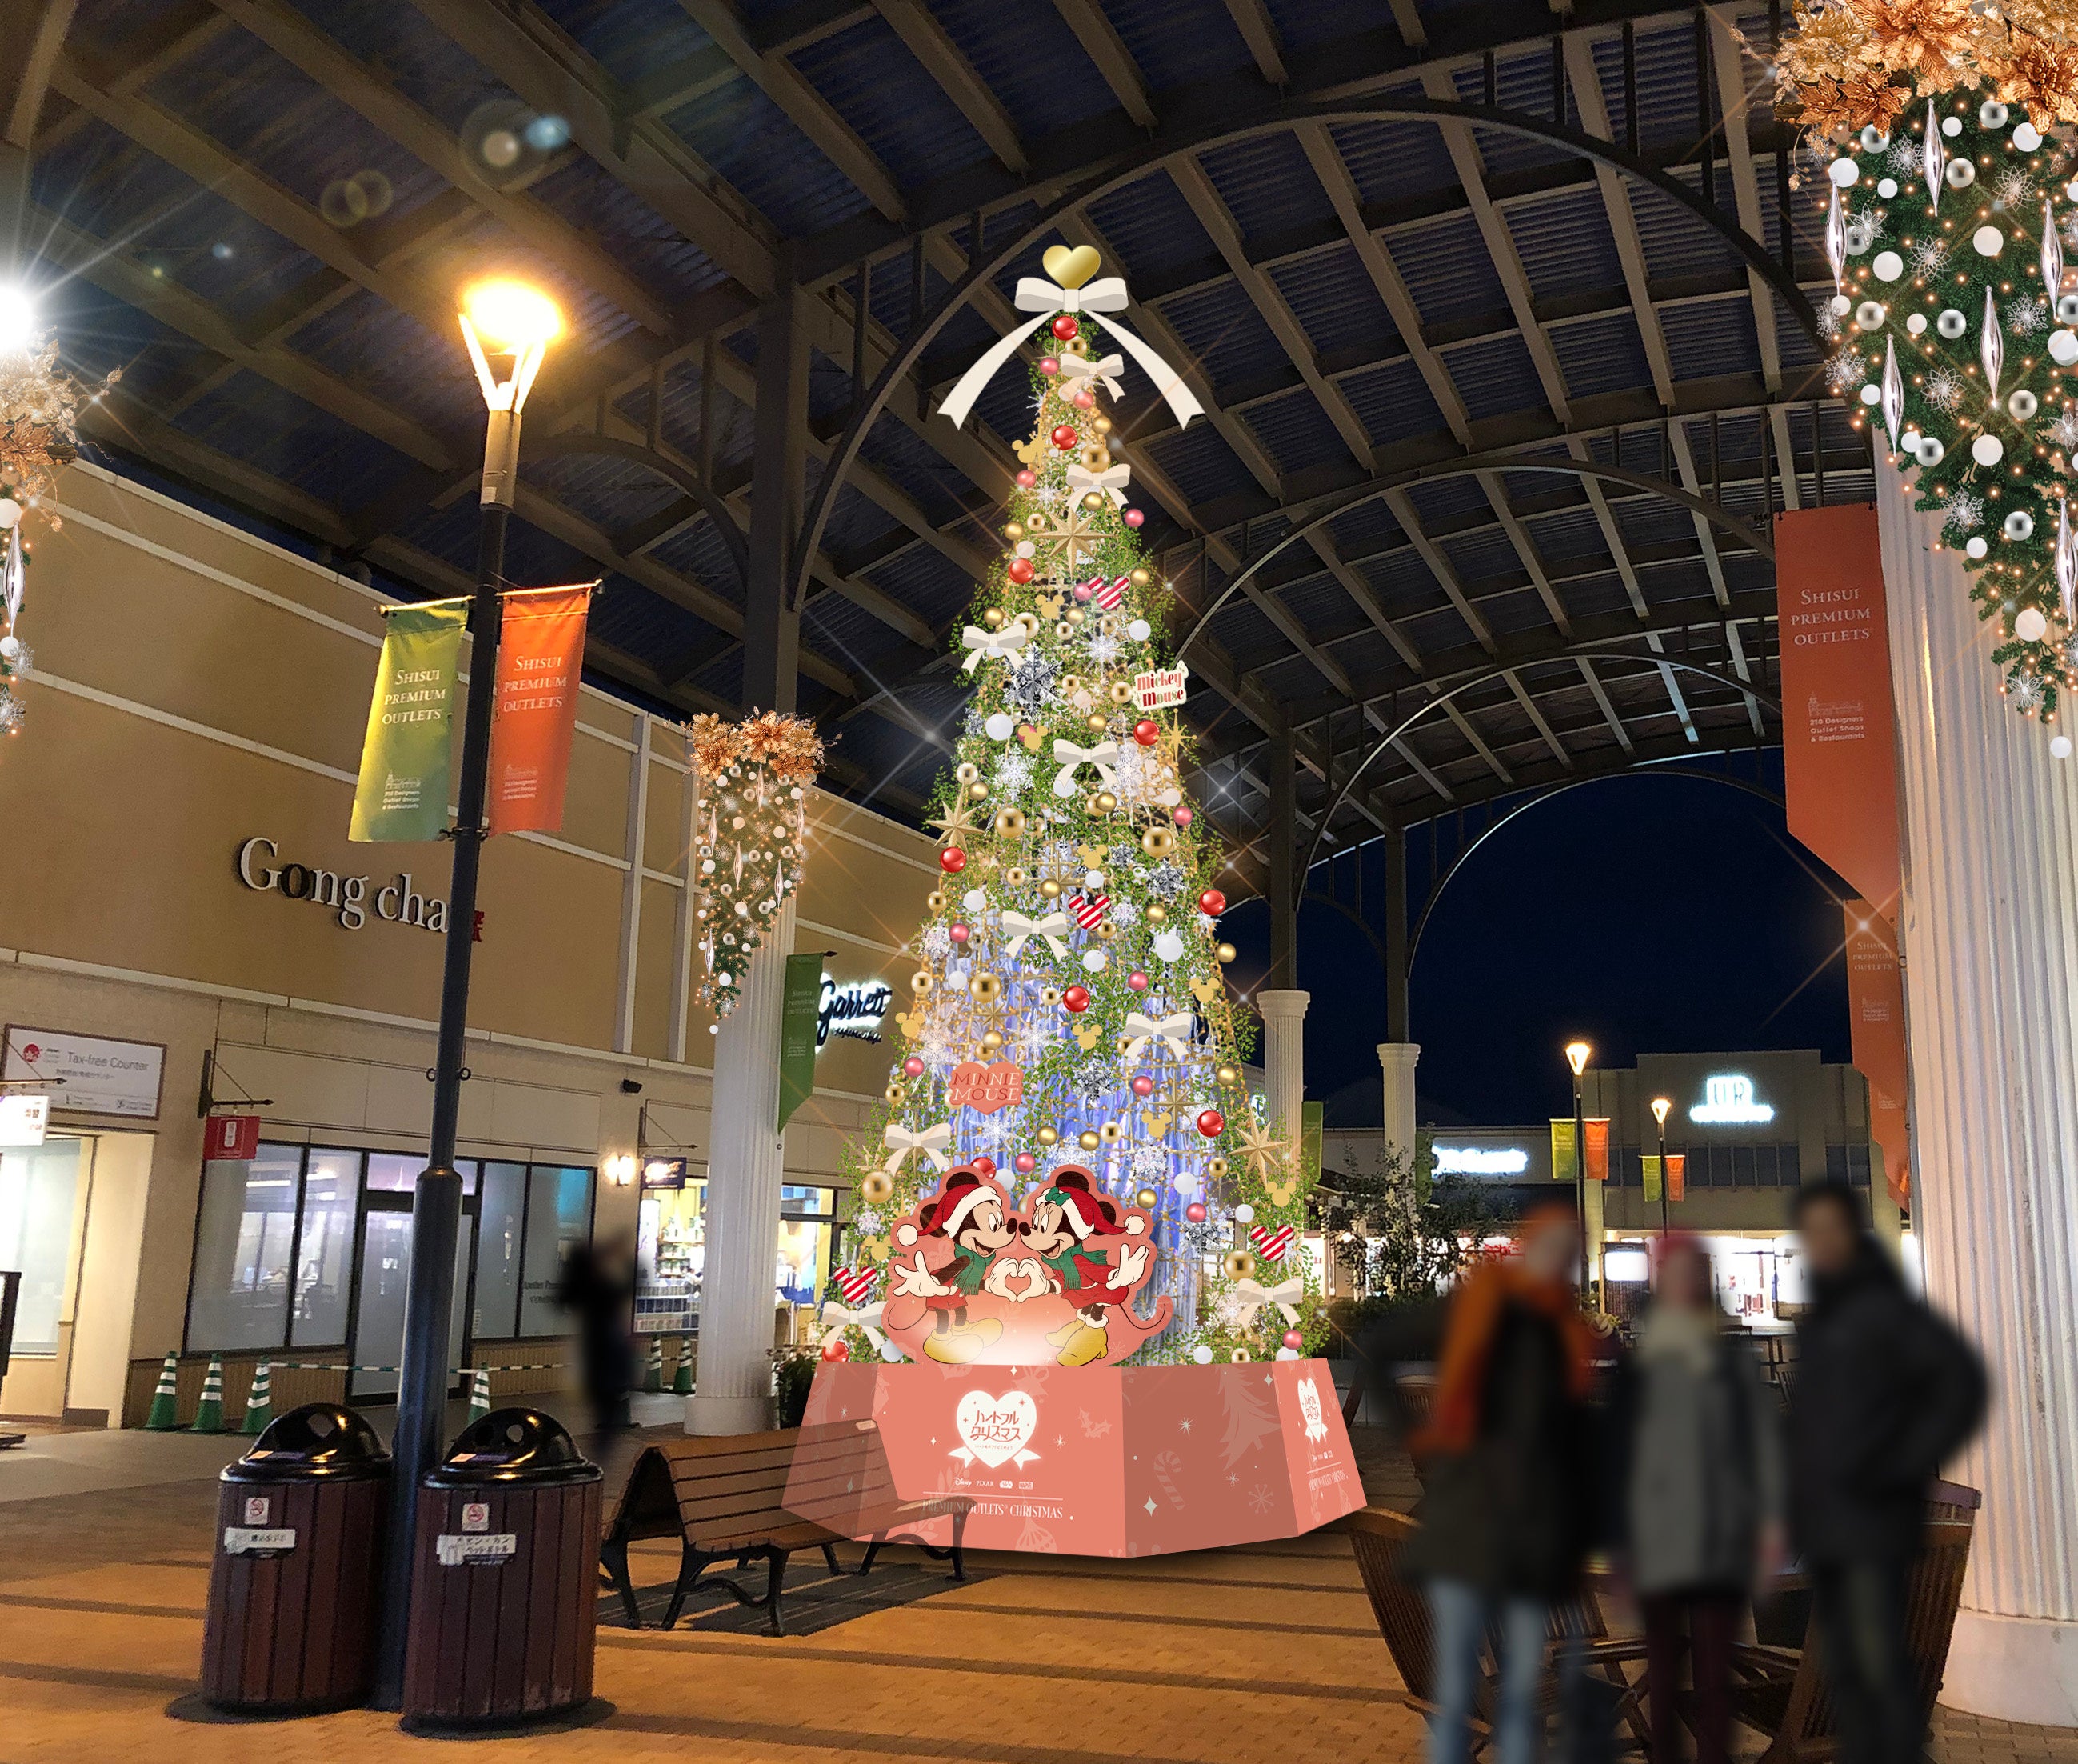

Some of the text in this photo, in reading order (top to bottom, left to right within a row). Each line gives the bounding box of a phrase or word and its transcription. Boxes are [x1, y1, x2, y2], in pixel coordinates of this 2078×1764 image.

[1800, 588, 1860, 605] SHISUI
[1791, 608, 1870, 626] PREMIUM
[1794, 628, 1870, 646] OUTLETS
[514, 655, 561, 671] SHISUI
[395, 670, 440, 685] SHISUI
[502, 677, 567, 693] PREMIUM
[385, 689, 446, 706] PREMIUM
[503, 696, 563, 712] OUTLETS
[382, 710, 441, 724] OUTLETS
[1825, 716, 1864, 724] Designers
[239, 837, 370, 930] Gong
[376, 874, 448, 934] cha
[817, 980, 893, 1046] Garrett
[68, 1051, 107, 1066] Tax-free
[110, 1057, 150, 1071] Counter
[953, 1072, 1020, 1085] MINNIE
[953, 1088, 1020, 1101] MOUSE
[974, 1410, 1020, 1426] ハートフル
[970, 1426, 1021, 1442] クリスマス
[1010, 1505, 1063, 1519] CHRISTMAS
